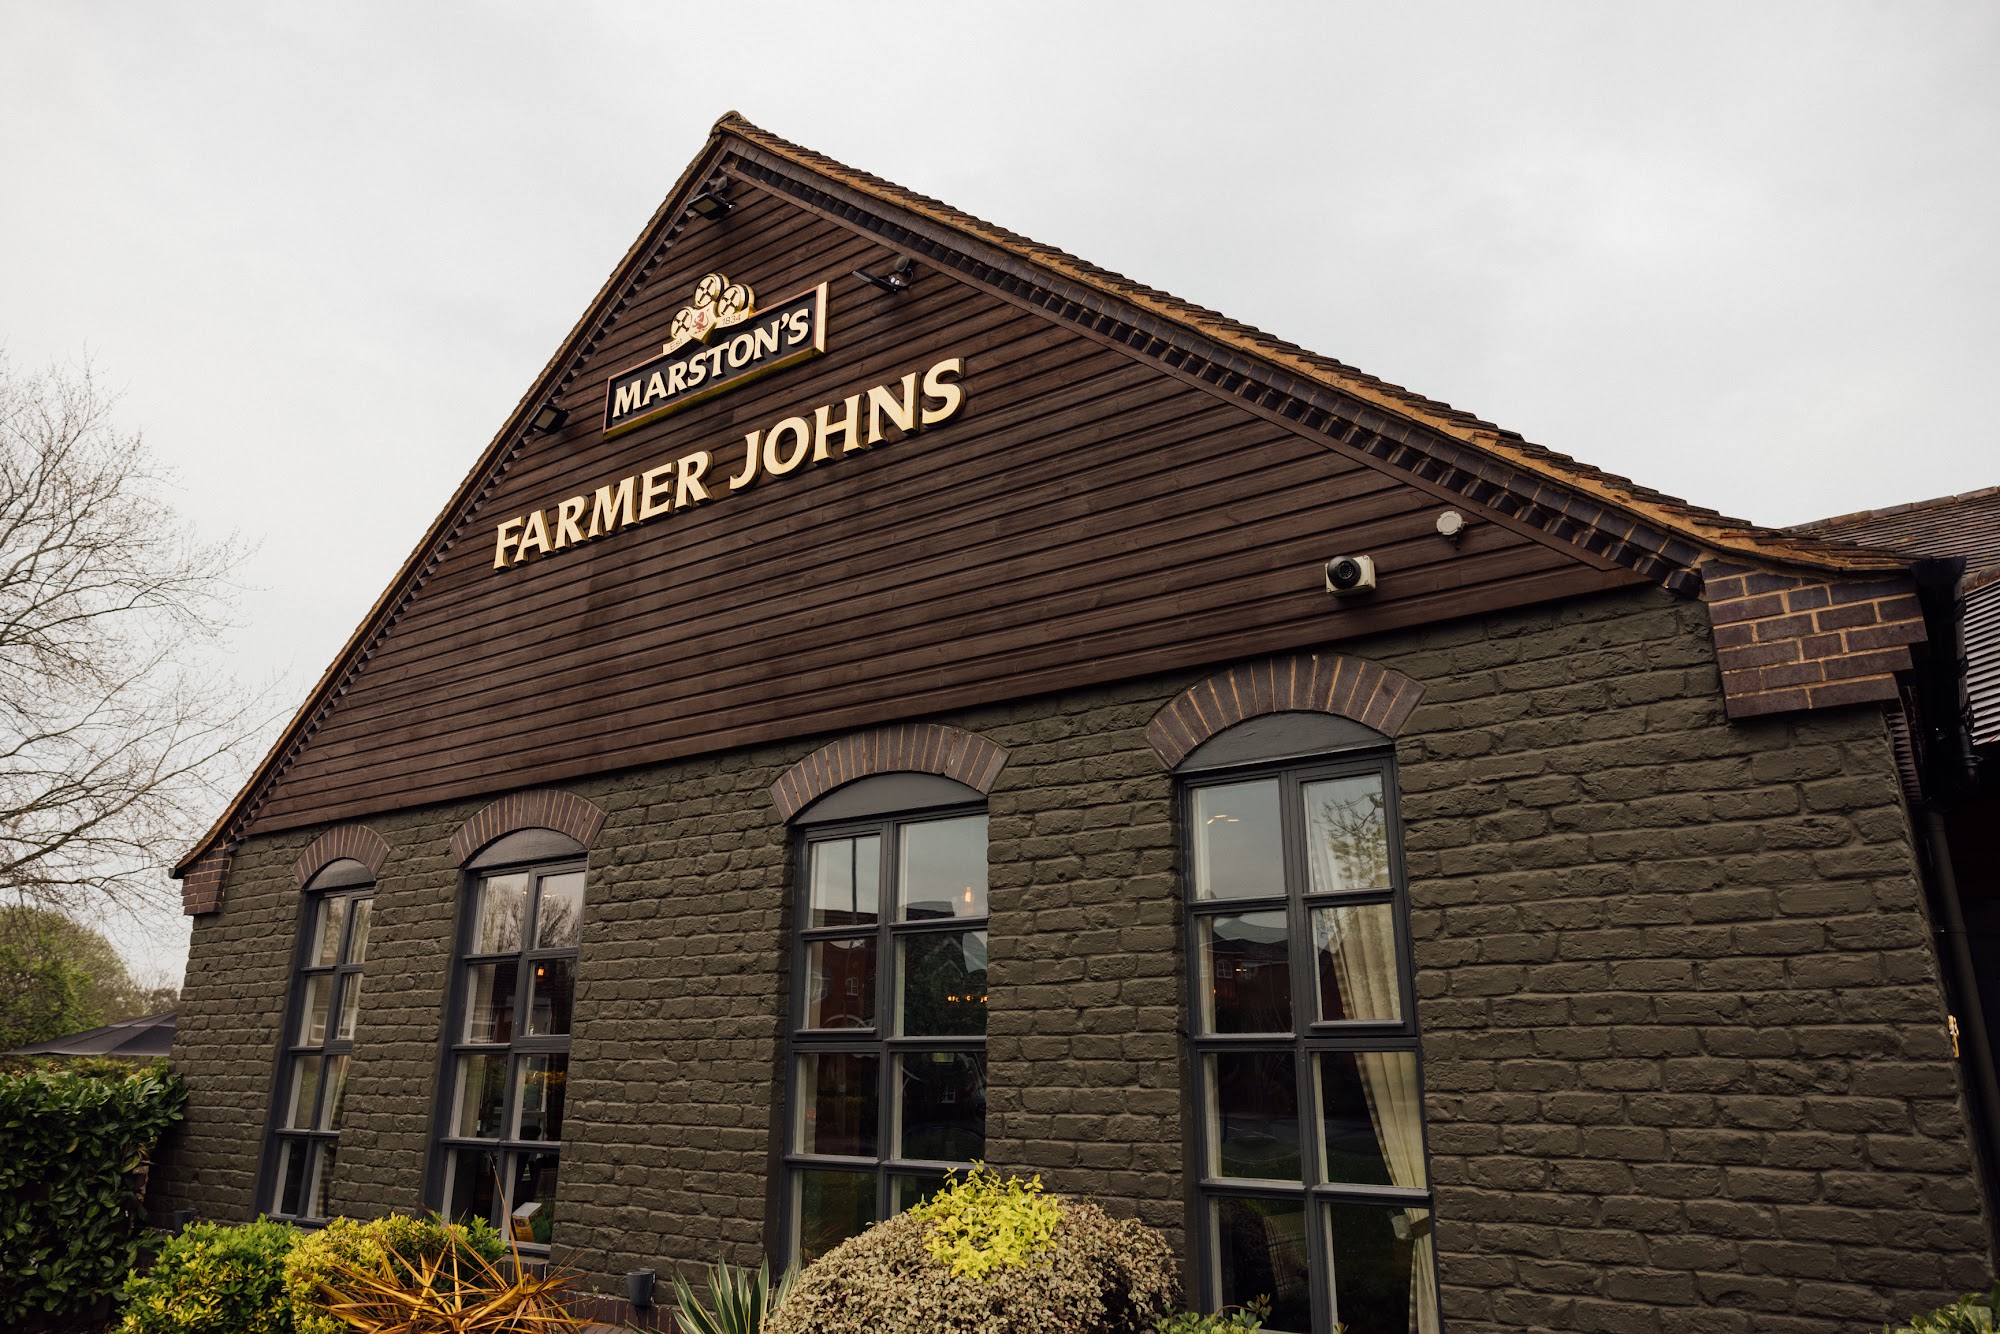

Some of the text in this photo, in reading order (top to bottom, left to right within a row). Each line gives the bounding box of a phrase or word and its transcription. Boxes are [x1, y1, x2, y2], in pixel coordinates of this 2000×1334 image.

[612, 308, 811, 419] MARSTON'S
[722, 314, 742, 326] 1834
[493, 357, 966, 571] FARMER JOHNS
